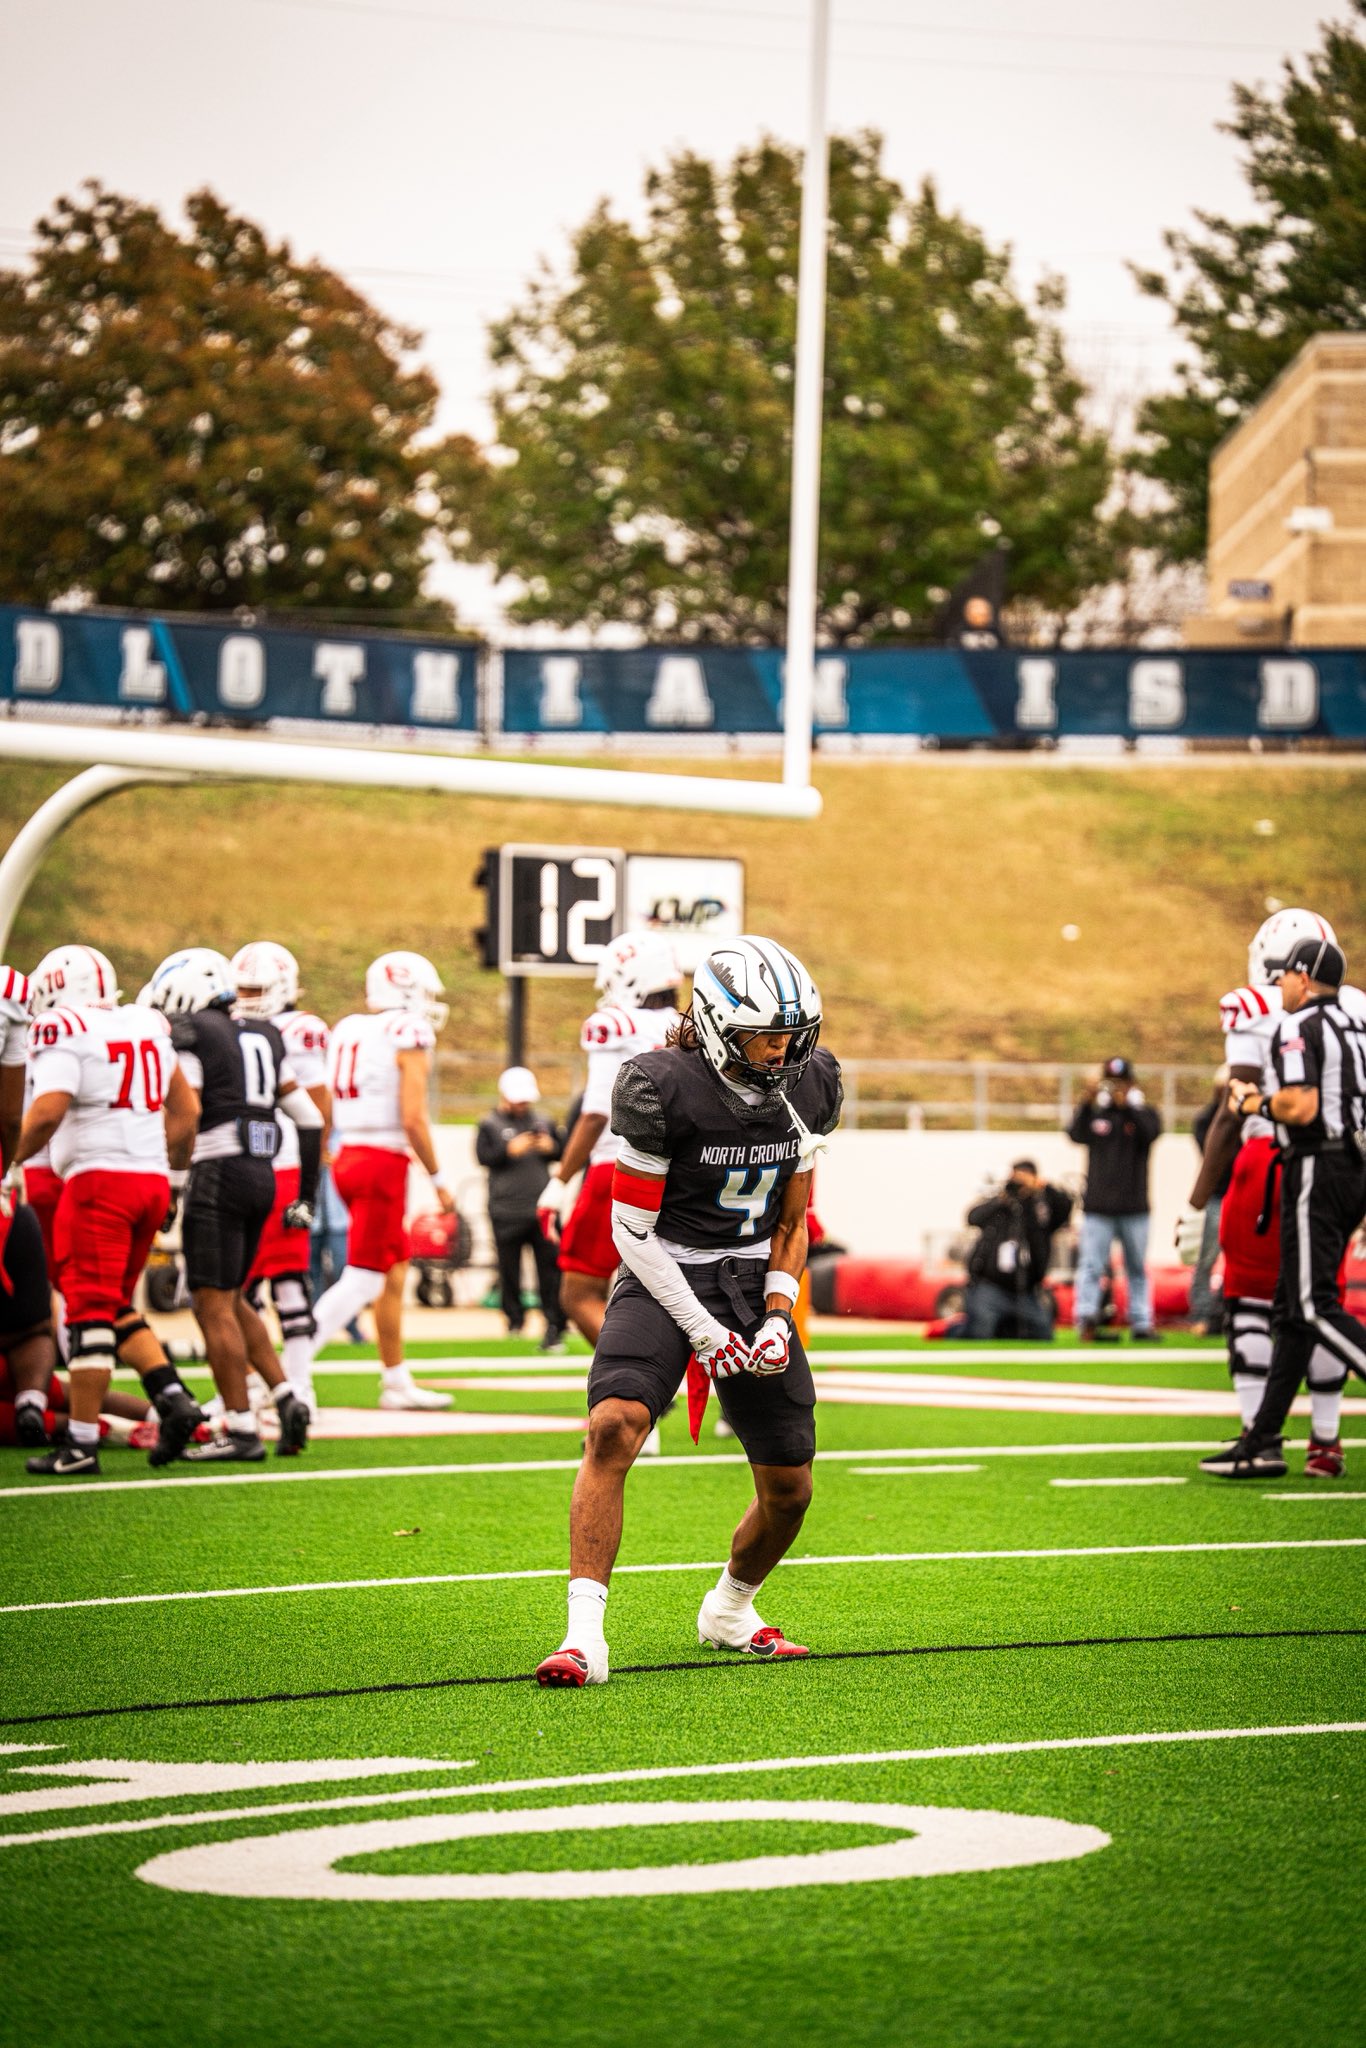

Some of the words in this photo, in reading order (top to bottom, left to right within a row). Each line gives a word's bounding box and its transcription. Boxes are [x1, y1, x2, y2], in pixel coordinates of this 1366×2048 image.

[540, 857, 616, 963] 12
[784, 1011, 801, 1026] 817
[106, 1039, 164, 1112] 70
[238, 1031, 277, 1109] 0
[699, 1145, 746, 1166] NORTH
[749, 1138, 801, 1164] CROWLE
[715, 1165, 781, 1237] 4
